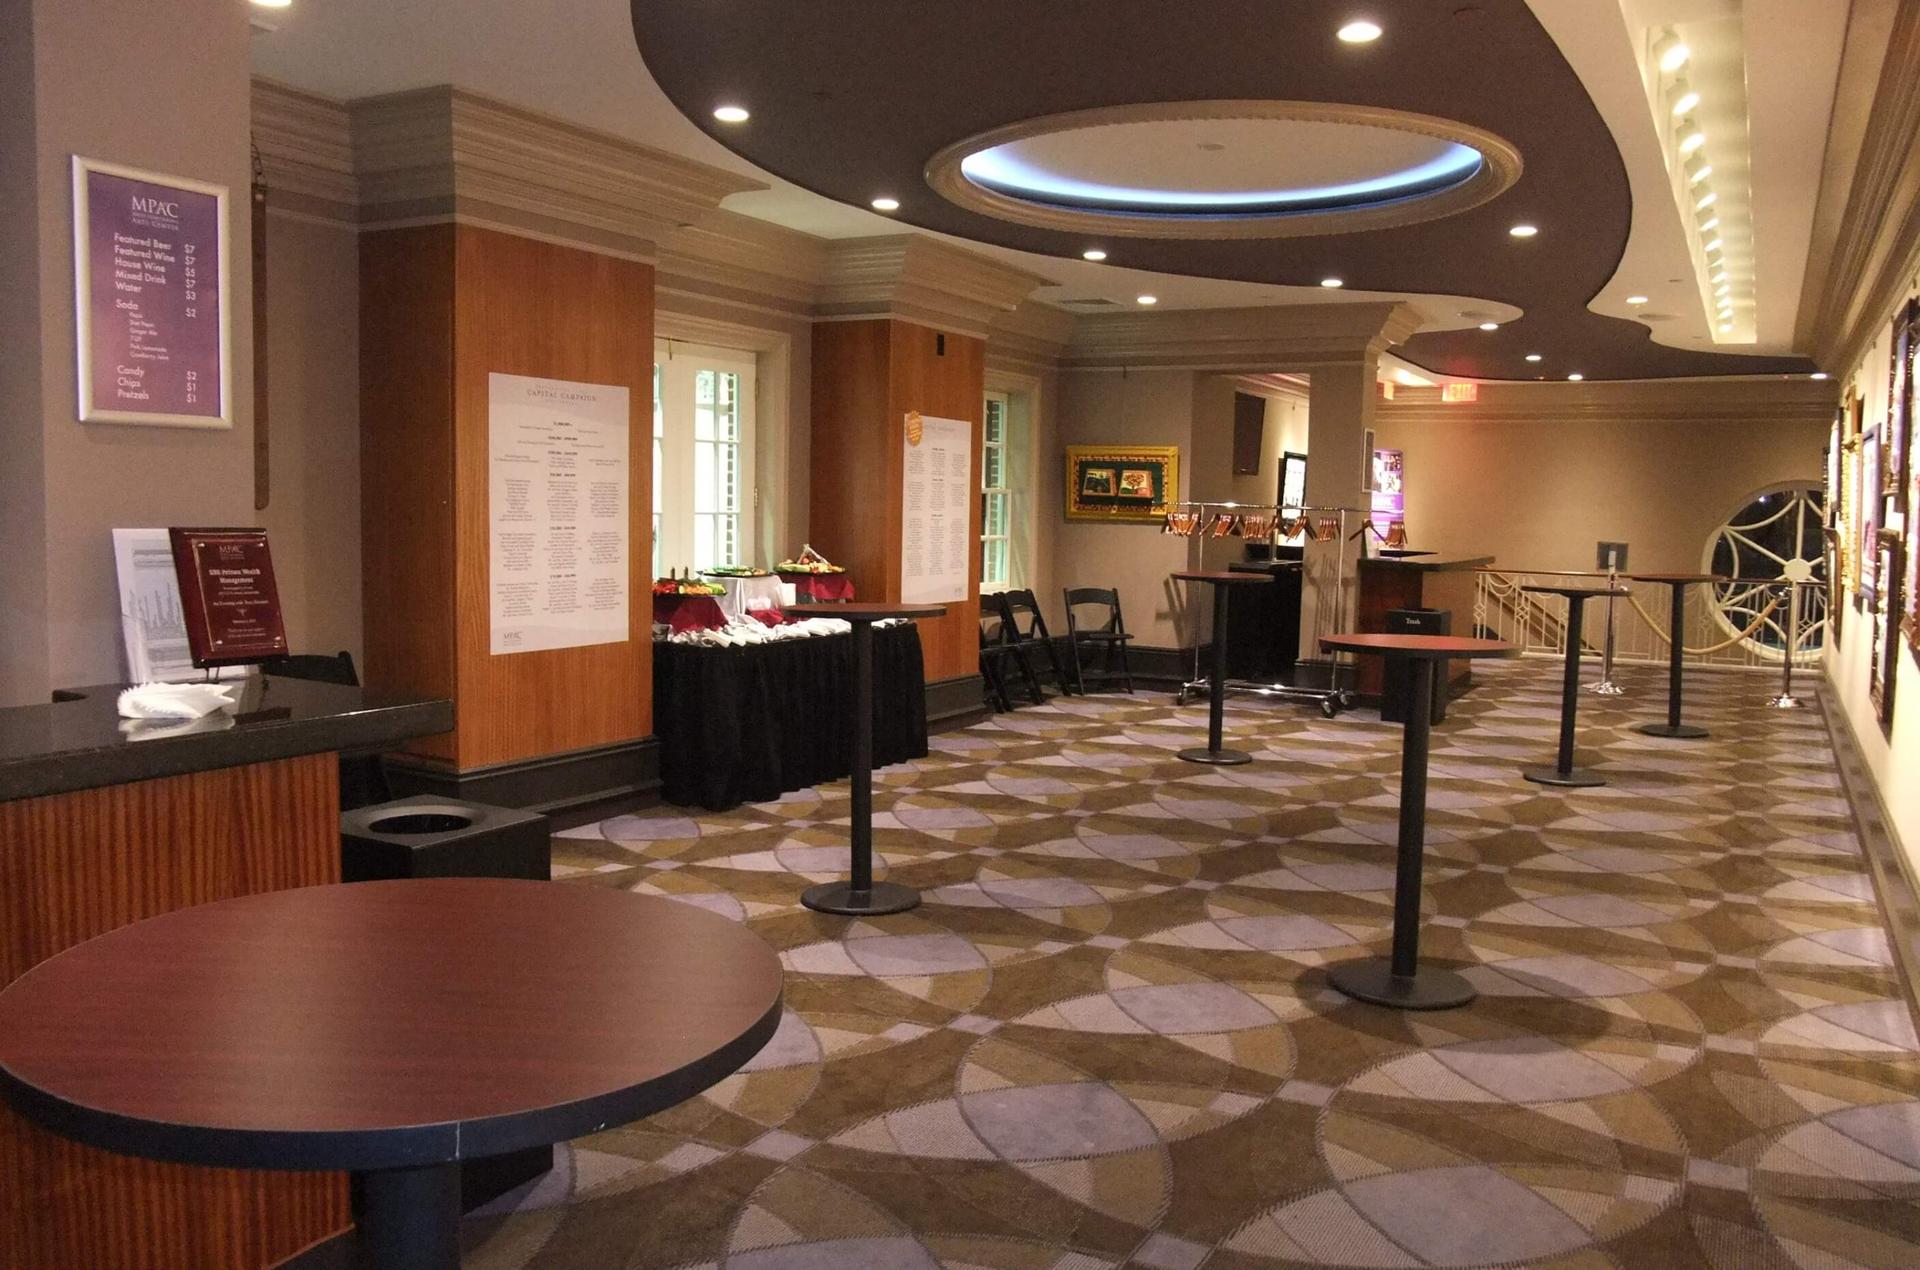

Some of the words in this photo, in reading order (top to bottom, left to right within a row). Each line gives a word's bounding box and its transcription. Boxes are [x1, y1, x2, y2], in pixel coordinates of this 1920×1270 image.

[132, 196, 179, 218] MPAC
[115, 233, 151, 247] Featured
[115, 245, 151, 259] Featured
[154, 252, 175, 263] Wine
[115, 257, 141, 269] House
[144, 262, 166, 273] Wine
[116, 270, 143, 281] Mixed
[145, 273, 166, 284] Drink
[116, 281, 142, 293] Water
[186, 291, 196, 300] $3
[116, 299, 139, 310] Soda
[186, 308, 196, 318] $2
[117, 365, 145, 378] Candy
[187, 371, 197, 381] $2
[117, 377, 141, 389] Chips
[187, 382, 196, 392] $1
[118, 389, 150, 400] Pretzels
[187, 394, 197, 403] $1
